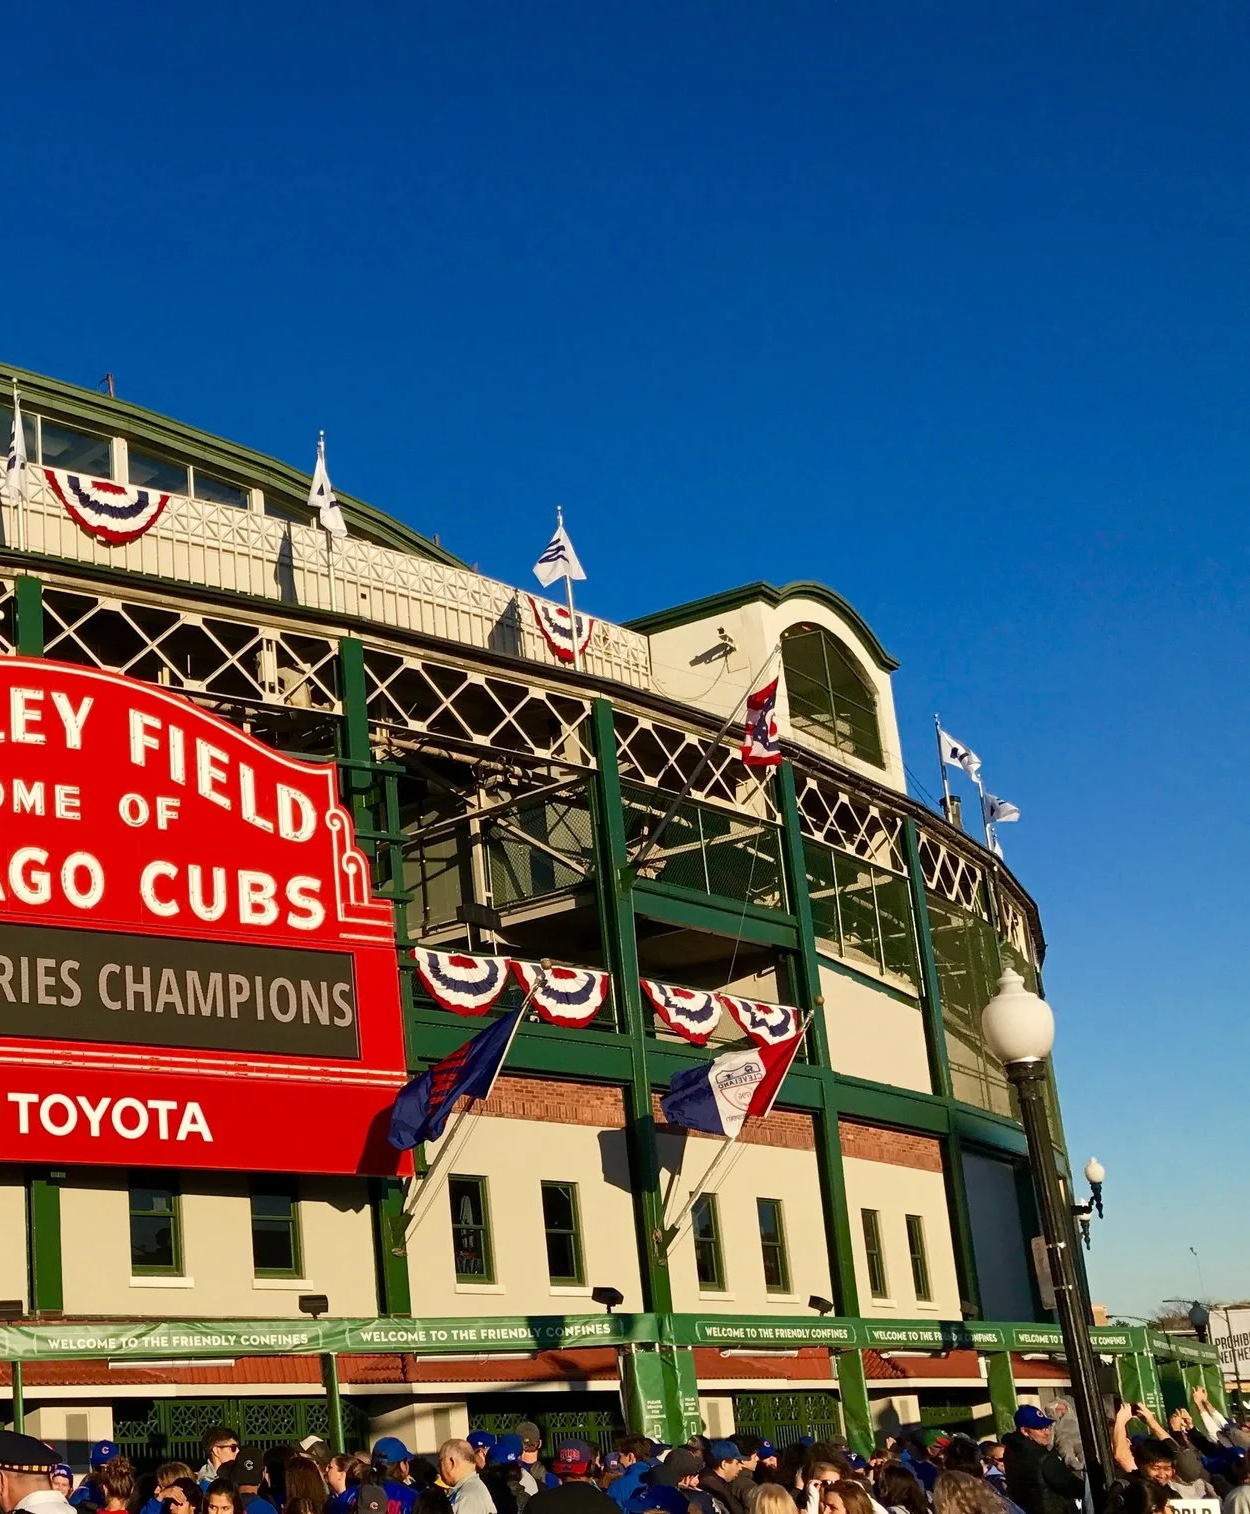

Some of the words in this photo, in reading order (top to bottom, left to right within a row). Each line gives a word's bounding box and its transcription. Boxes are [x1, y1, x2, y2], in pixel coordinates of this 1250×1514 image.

[128, 707, 317, 843] FIELD
[118, 792, 181, 831] OF
[139, 860, 326, 931] CUBS
[98, 963, 353, 1027] CHAMPIONS
[7, 1092, 214, 1142] TOYOTA
[360, 1331, 426, 1342] WELCOME
[431, 1331, 447, 1341] TO
[451, 1330, 477, 1340] THE
[480, 1328, 542, 1340] FRIENDLY
[546, 1323, 611, 1338] CONFINES
[705, 1326, 744, 1338] WELCOME
[746, 1327, 757, 1338] TO
[758, 1328, 774, 1338] THE
[775, 1328, 811, 1338] FRIENDLY
[811, 1329, 848, 1339] CONFINES
[872, 1330, 907, 1341] WELCOME
[908, 1331, 919, 1341] TO
[919, 1332, 933, 1341] THE
[1018, 1334, 1049, 1344] WELCOME
[1049, 1335, 1058, 1344] TO
[1098, 1336, 1127, 1345] CONFINES
[1215, 1331, 1250, 1350] PROHIB
[48, 1338, 116, 1350] WELCOME
[121, 1338, 138, 1348] TO
[142, 1337, 168, 1347] THE
[172, 1335, 236, 1347] FRIENDLY
[241, 1334, 309, 1346] CONFINES
[1219, 1347, 1250, 1364] NEITHE
[101, 1446, 110, 1454] C
[244, 1459, 254, 1470] C
[369, 1501, 378, 1510] C
